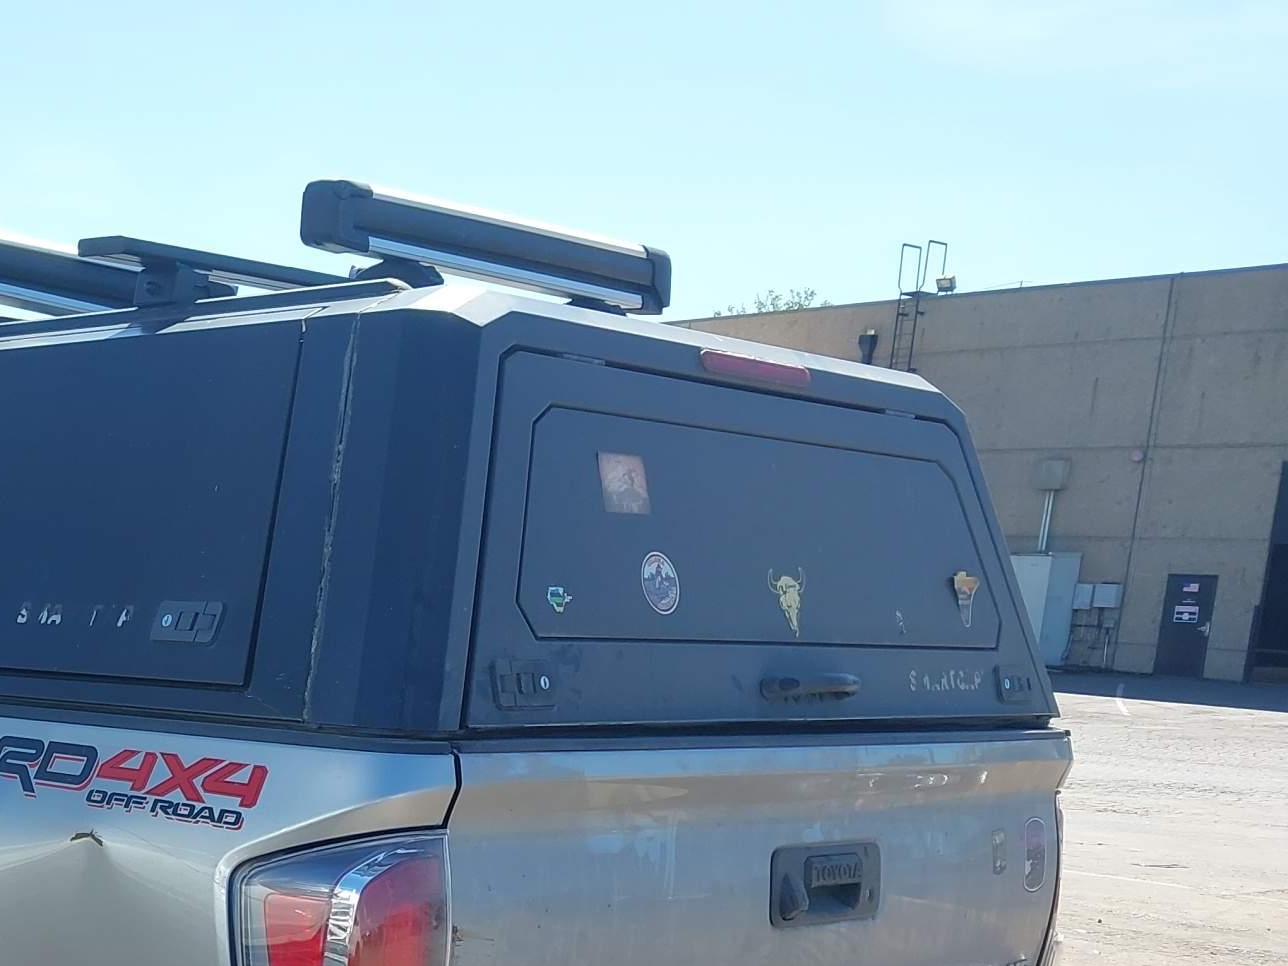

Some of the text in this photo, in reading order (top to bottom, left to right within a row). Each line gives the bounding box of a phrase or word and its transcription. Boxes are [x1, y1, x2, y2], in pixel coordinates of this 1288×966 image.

[96, 749, 269, 809] 4X4
[85, 788, 245, 831] OFF ROAD
[813, 862, 863, 882] TOYOTA
